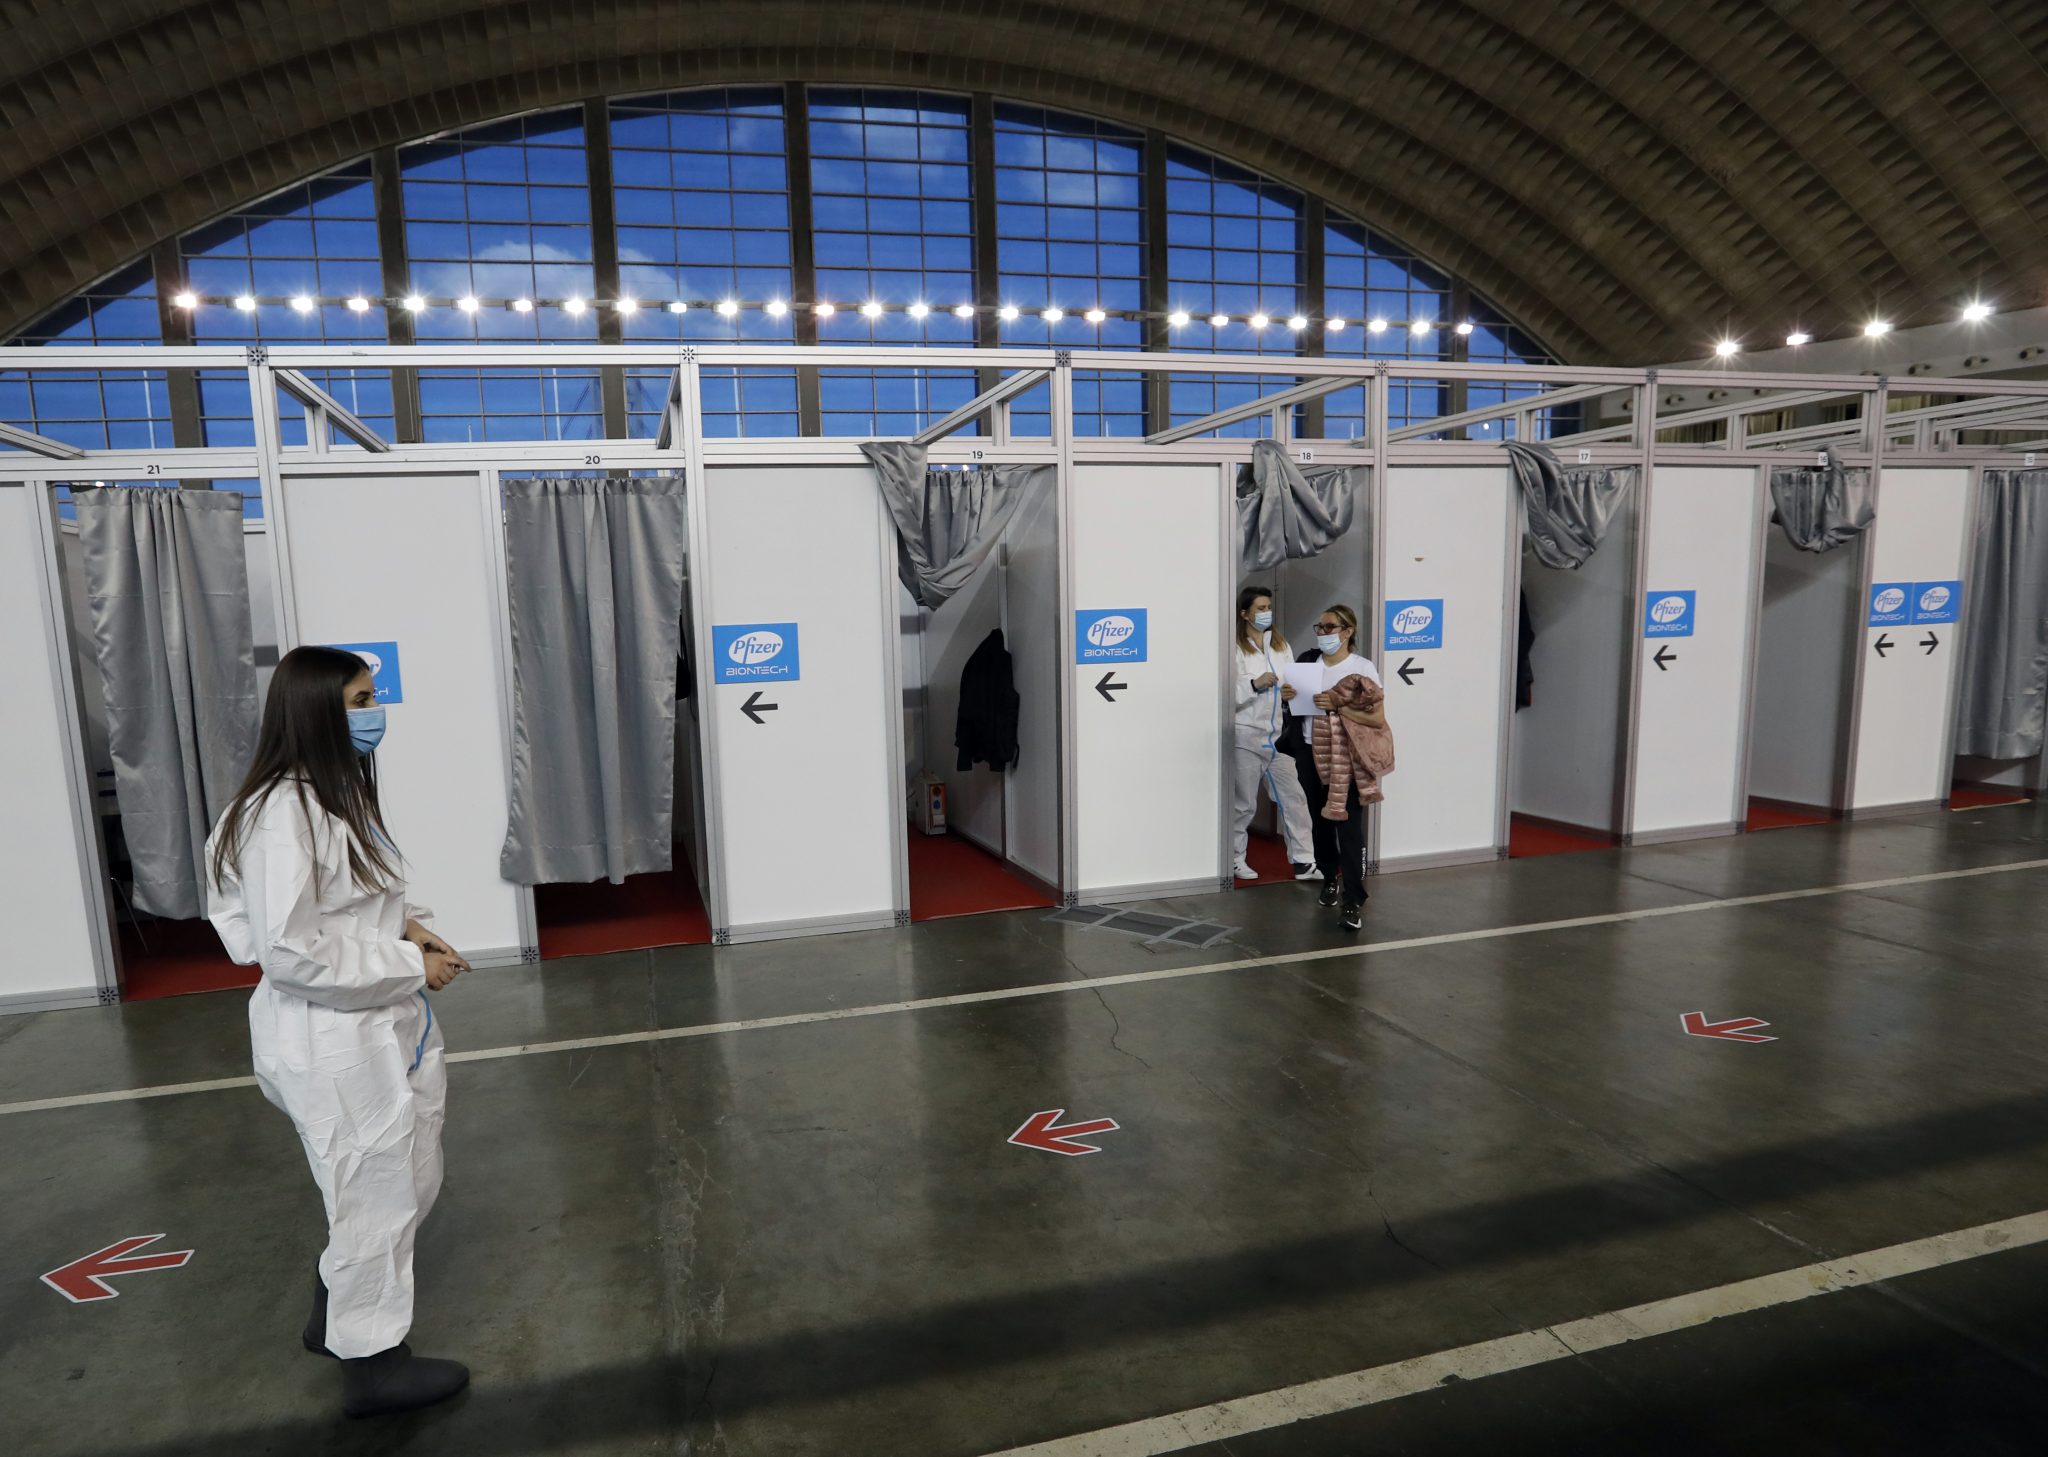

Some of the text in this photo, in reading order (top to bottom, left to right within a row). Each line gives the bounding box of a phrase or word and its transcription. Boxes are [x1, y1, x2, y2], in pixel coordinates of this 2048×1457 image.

[585, 456, 601, 464] 20
[972, 451, 983, 459] 19
[1581, 453, 1589, 461] 17
[147, 465, 160, 474] 21
[1876, 592, 1903, 613] Pfizer
[1922, 590, 1949, 611] Pfizer
[1653, 600, 1685, 622] Pfizer
[1396, 610, 1431, 635] Pfizer
[1091, 620, 1133, 647] Pfizer
[1389, 634, 1435, 644] BIONTECH
[732, 633, 781, 664] Pfizer
[1084, 647, 1138, 657] BIONTECH
[725, 665, 788, 676] BIONTECH
